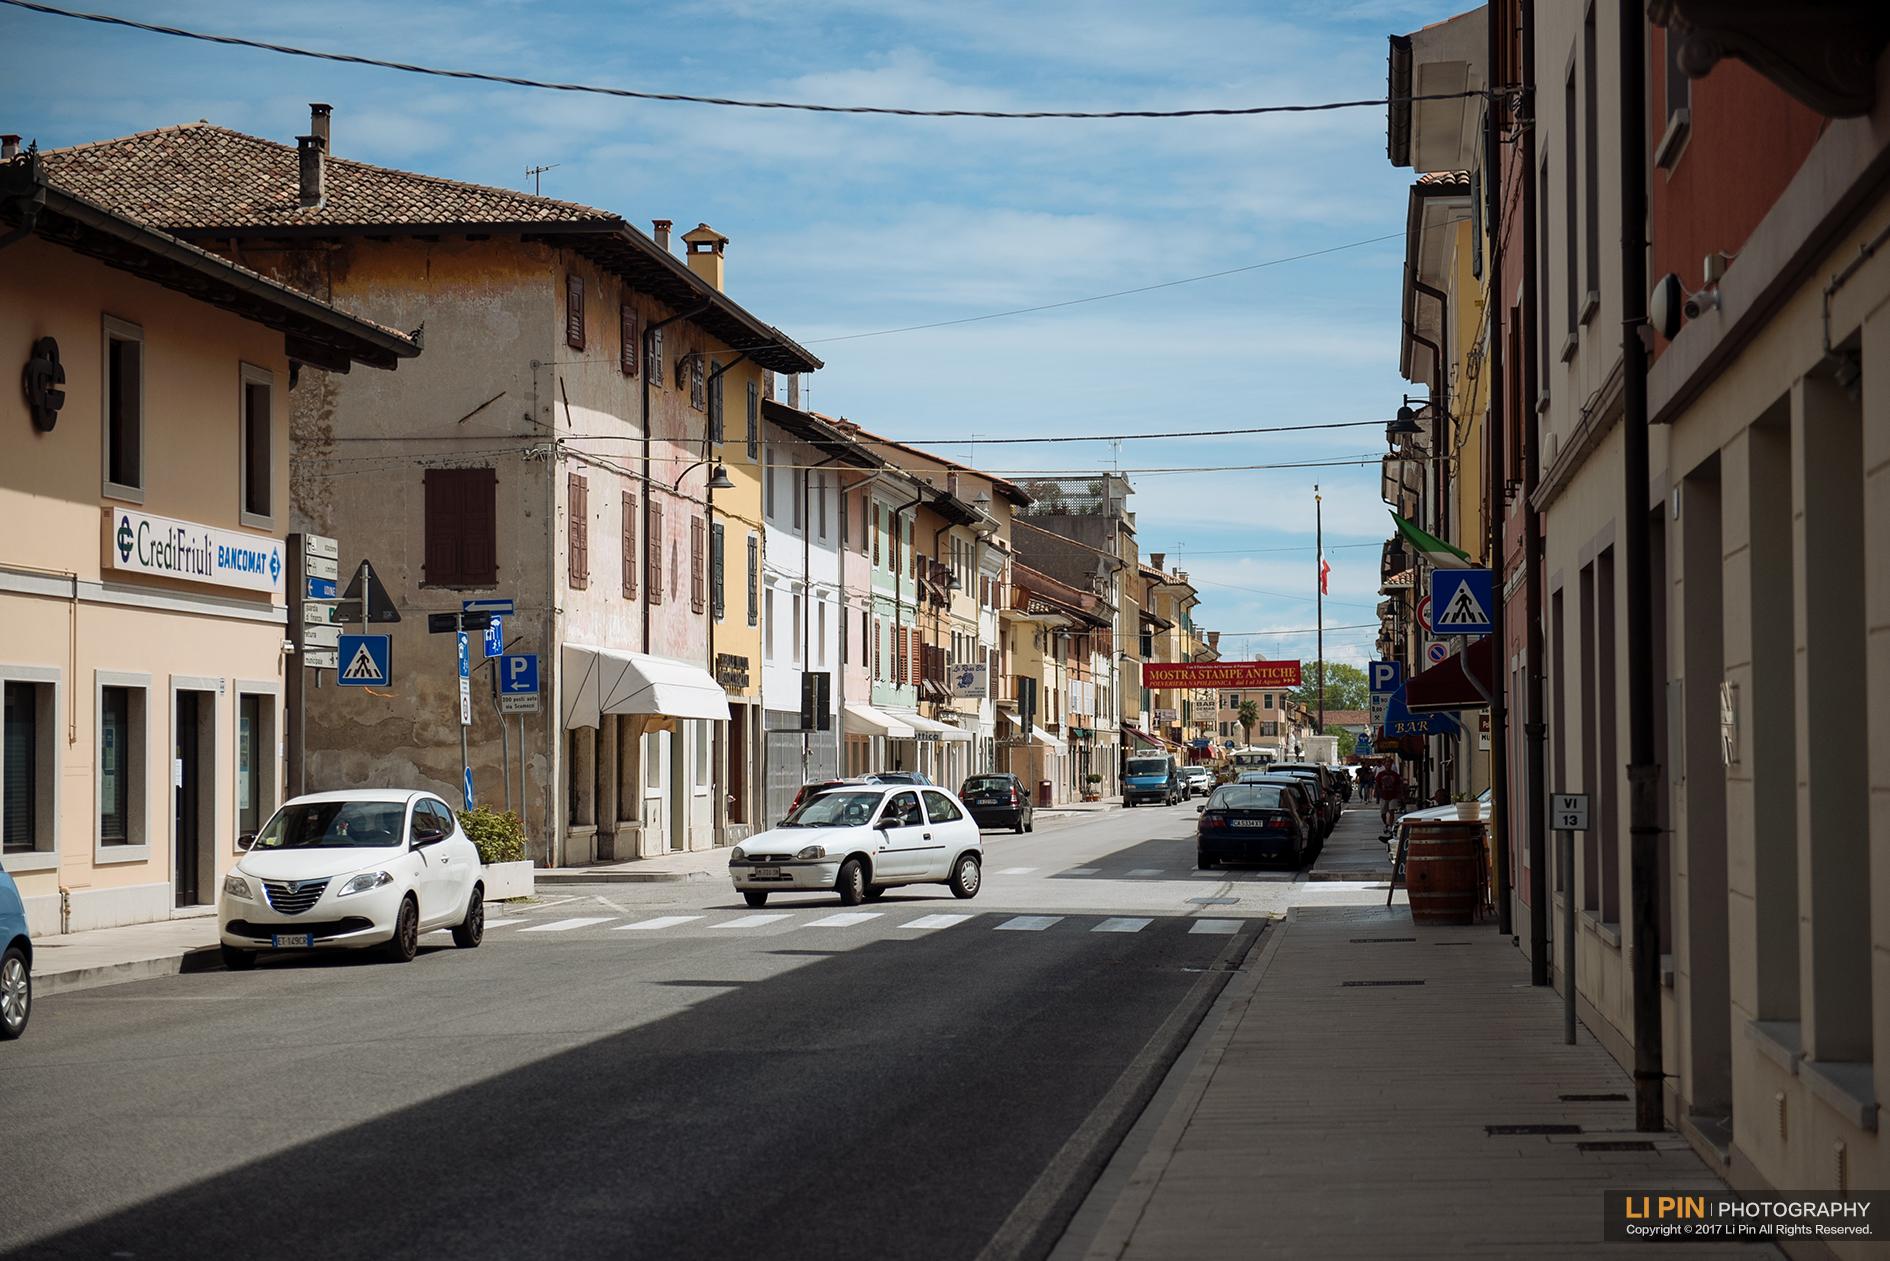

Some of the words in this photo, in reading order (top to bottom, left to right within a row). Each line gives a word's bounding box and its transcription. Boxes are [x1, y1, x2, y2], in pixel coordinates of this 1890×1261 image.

[138, 520, 212, 577] CrediFriuli
[218, 545, 267, 575] BANCOMAT
[510, 657, 528, 680] P
[1150, 669, 1196, 681] MOSTRA
[1199, 669, 1244, 680] STAMPE
[1245, 667, 1296, 678] ANTICHE
[1375, 664, 1394, 689] P
[1394, 720, 1429, 734] BAR
[1563, 798, 1577, 809] VI
[1563, 815, 1578, 826] 13
